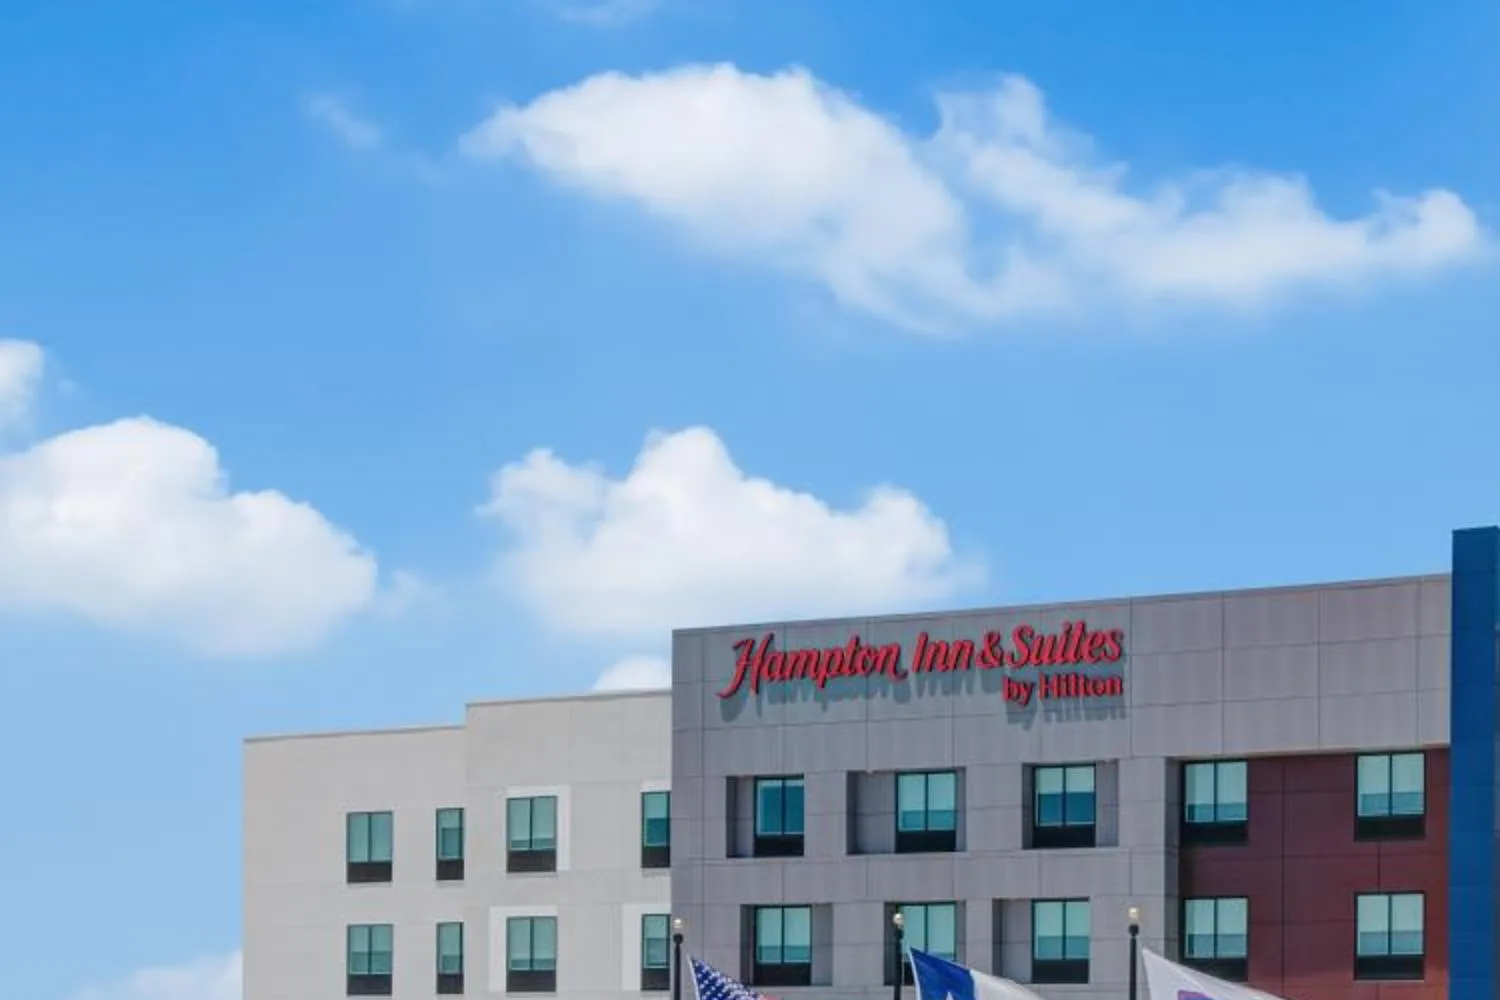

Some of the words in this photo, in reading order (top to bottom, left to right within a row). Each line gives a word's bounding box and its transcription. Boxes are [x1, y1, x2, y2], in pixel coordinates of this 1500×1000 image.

[716, 632, 909, 699] Hampton
[911, 631, 975, 673] Inn
[1005, 619, 1124, 668] Suites
[1002, 674, 1035, 707] by
[1038, 671, 1124, 699] Hilton
